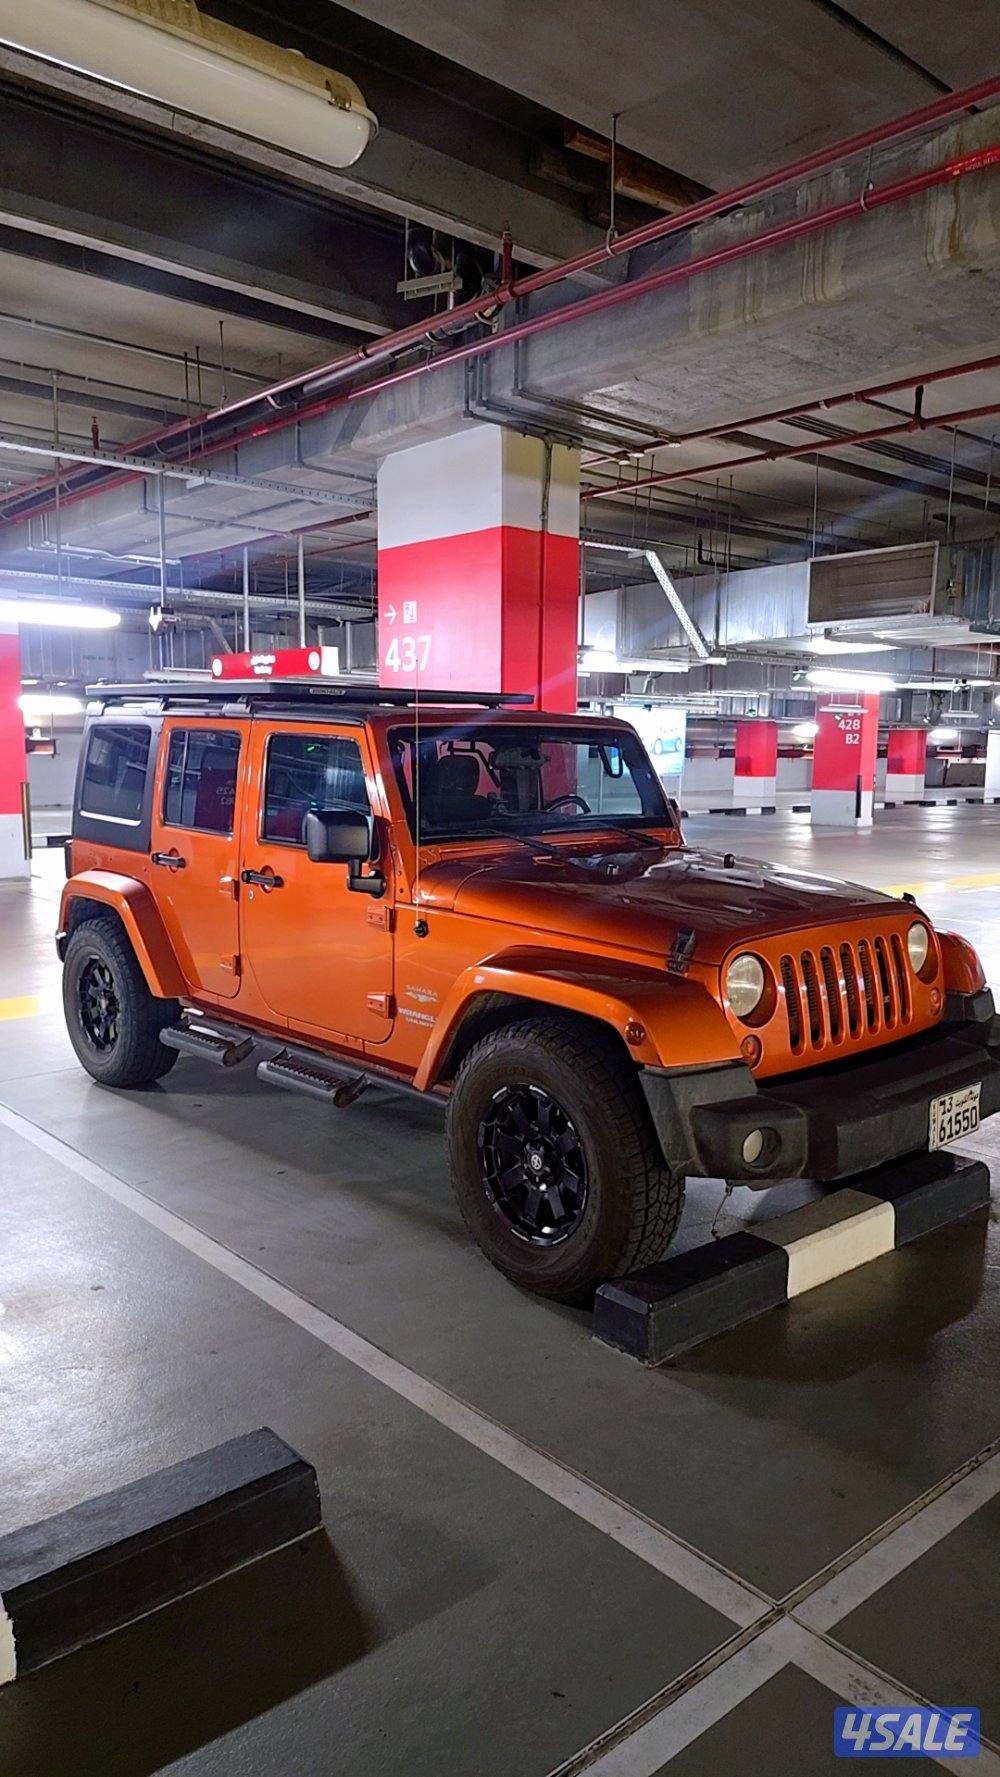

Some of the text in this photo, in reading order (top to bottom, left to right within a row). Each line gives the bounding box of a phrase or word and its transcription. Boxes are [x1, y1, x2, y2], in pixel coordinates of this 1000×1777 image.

[384, 634, 432, 673] 437
[838, 719, 861, 731] 428
[845, 733, 860, 745] B2
[939, 1105, 978, 1143] 61550
